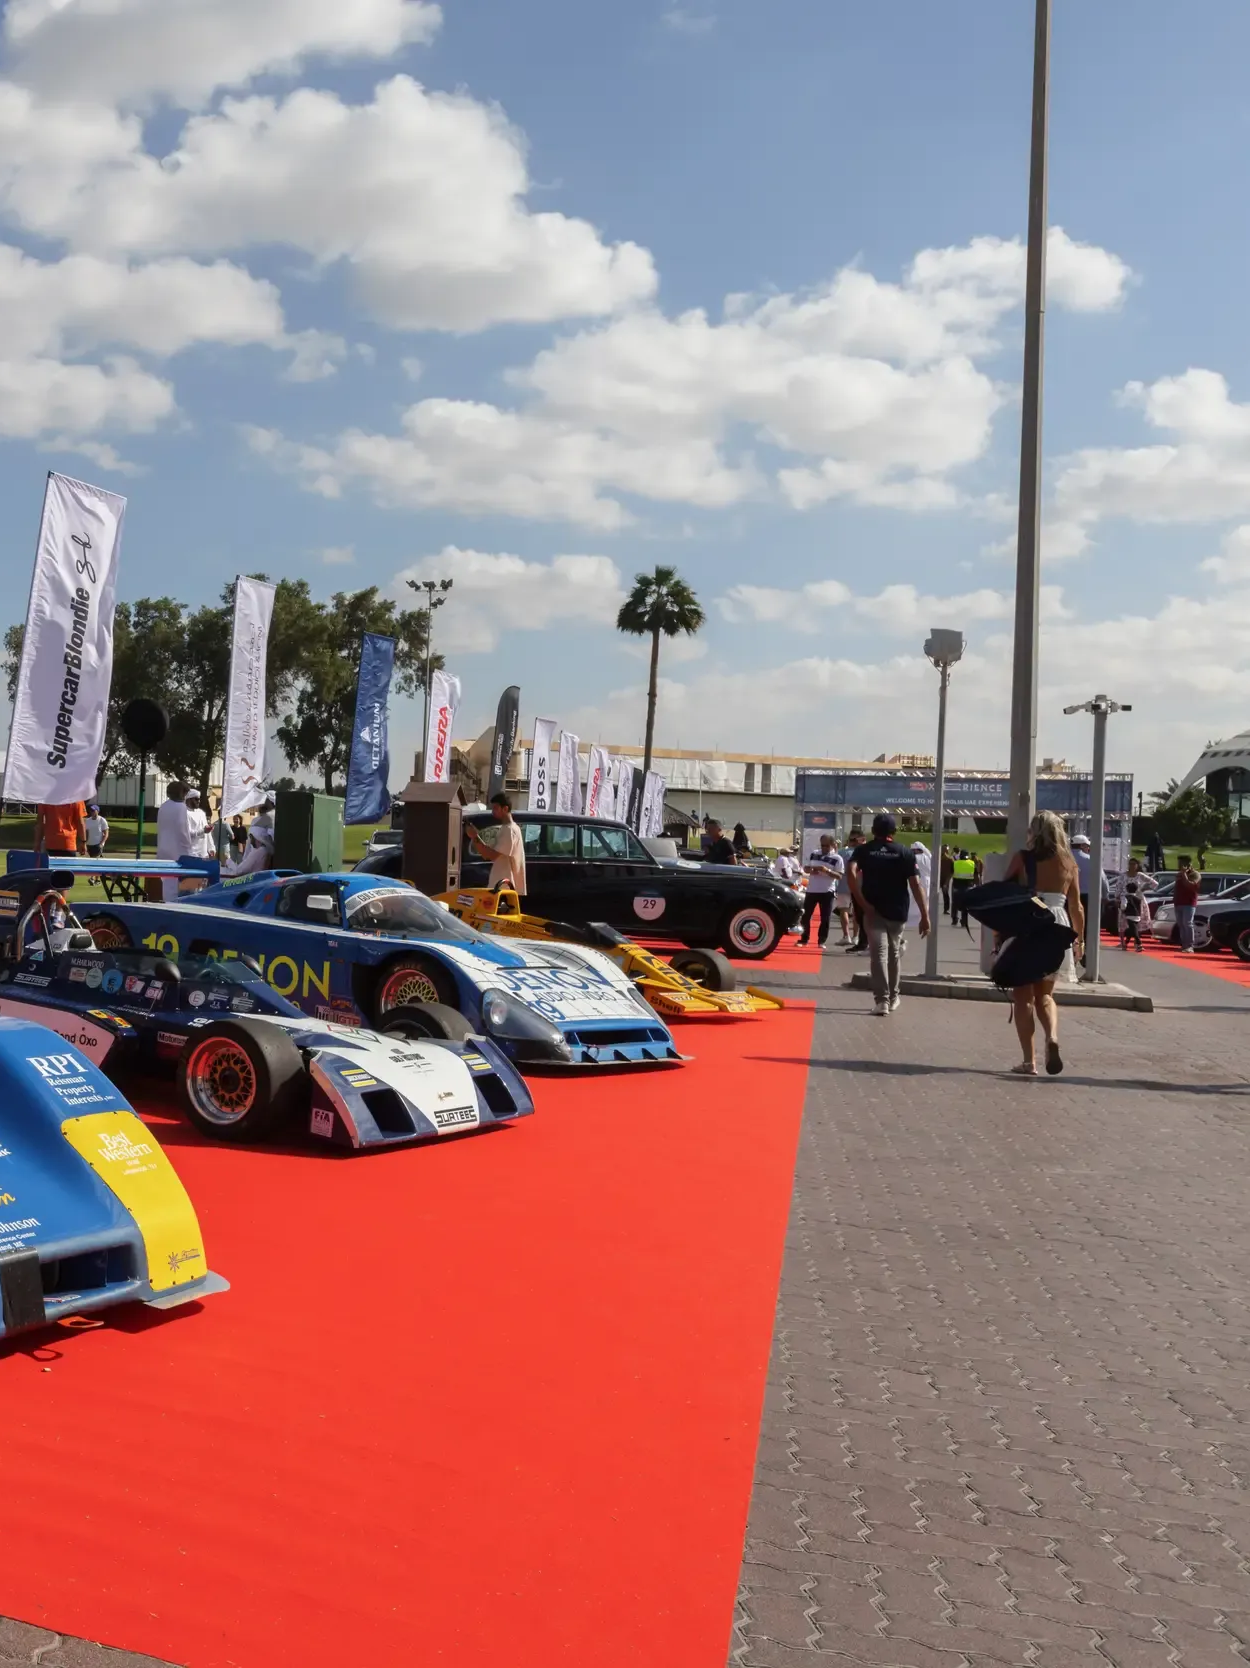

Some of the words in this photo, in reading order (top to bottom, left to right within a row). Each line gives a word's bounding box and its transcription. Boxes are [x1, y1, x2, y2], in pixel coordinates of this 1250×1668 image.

[46, 587, 91, 770] SupercarBlondie
[536, 756, 547, 810] BOSS
[642, 899, 657, 909] 29
[14, 972, 52, 987] SURTEES
[494, 965, 618, 993] DENON
[650, 995, 681, 1014] Shell
[79, 1034, 98, 1047] Oxo
[26, 1053, 89, 1078] RPI
[45, 1075, 87, 1087] Reisman
[54, 1084, 96, 1096] Property
[433, 1105, 478, 1128] SURTEES
[98, 1130, 132, 1150] Best
[97, 1143, 153, 1163] Western
